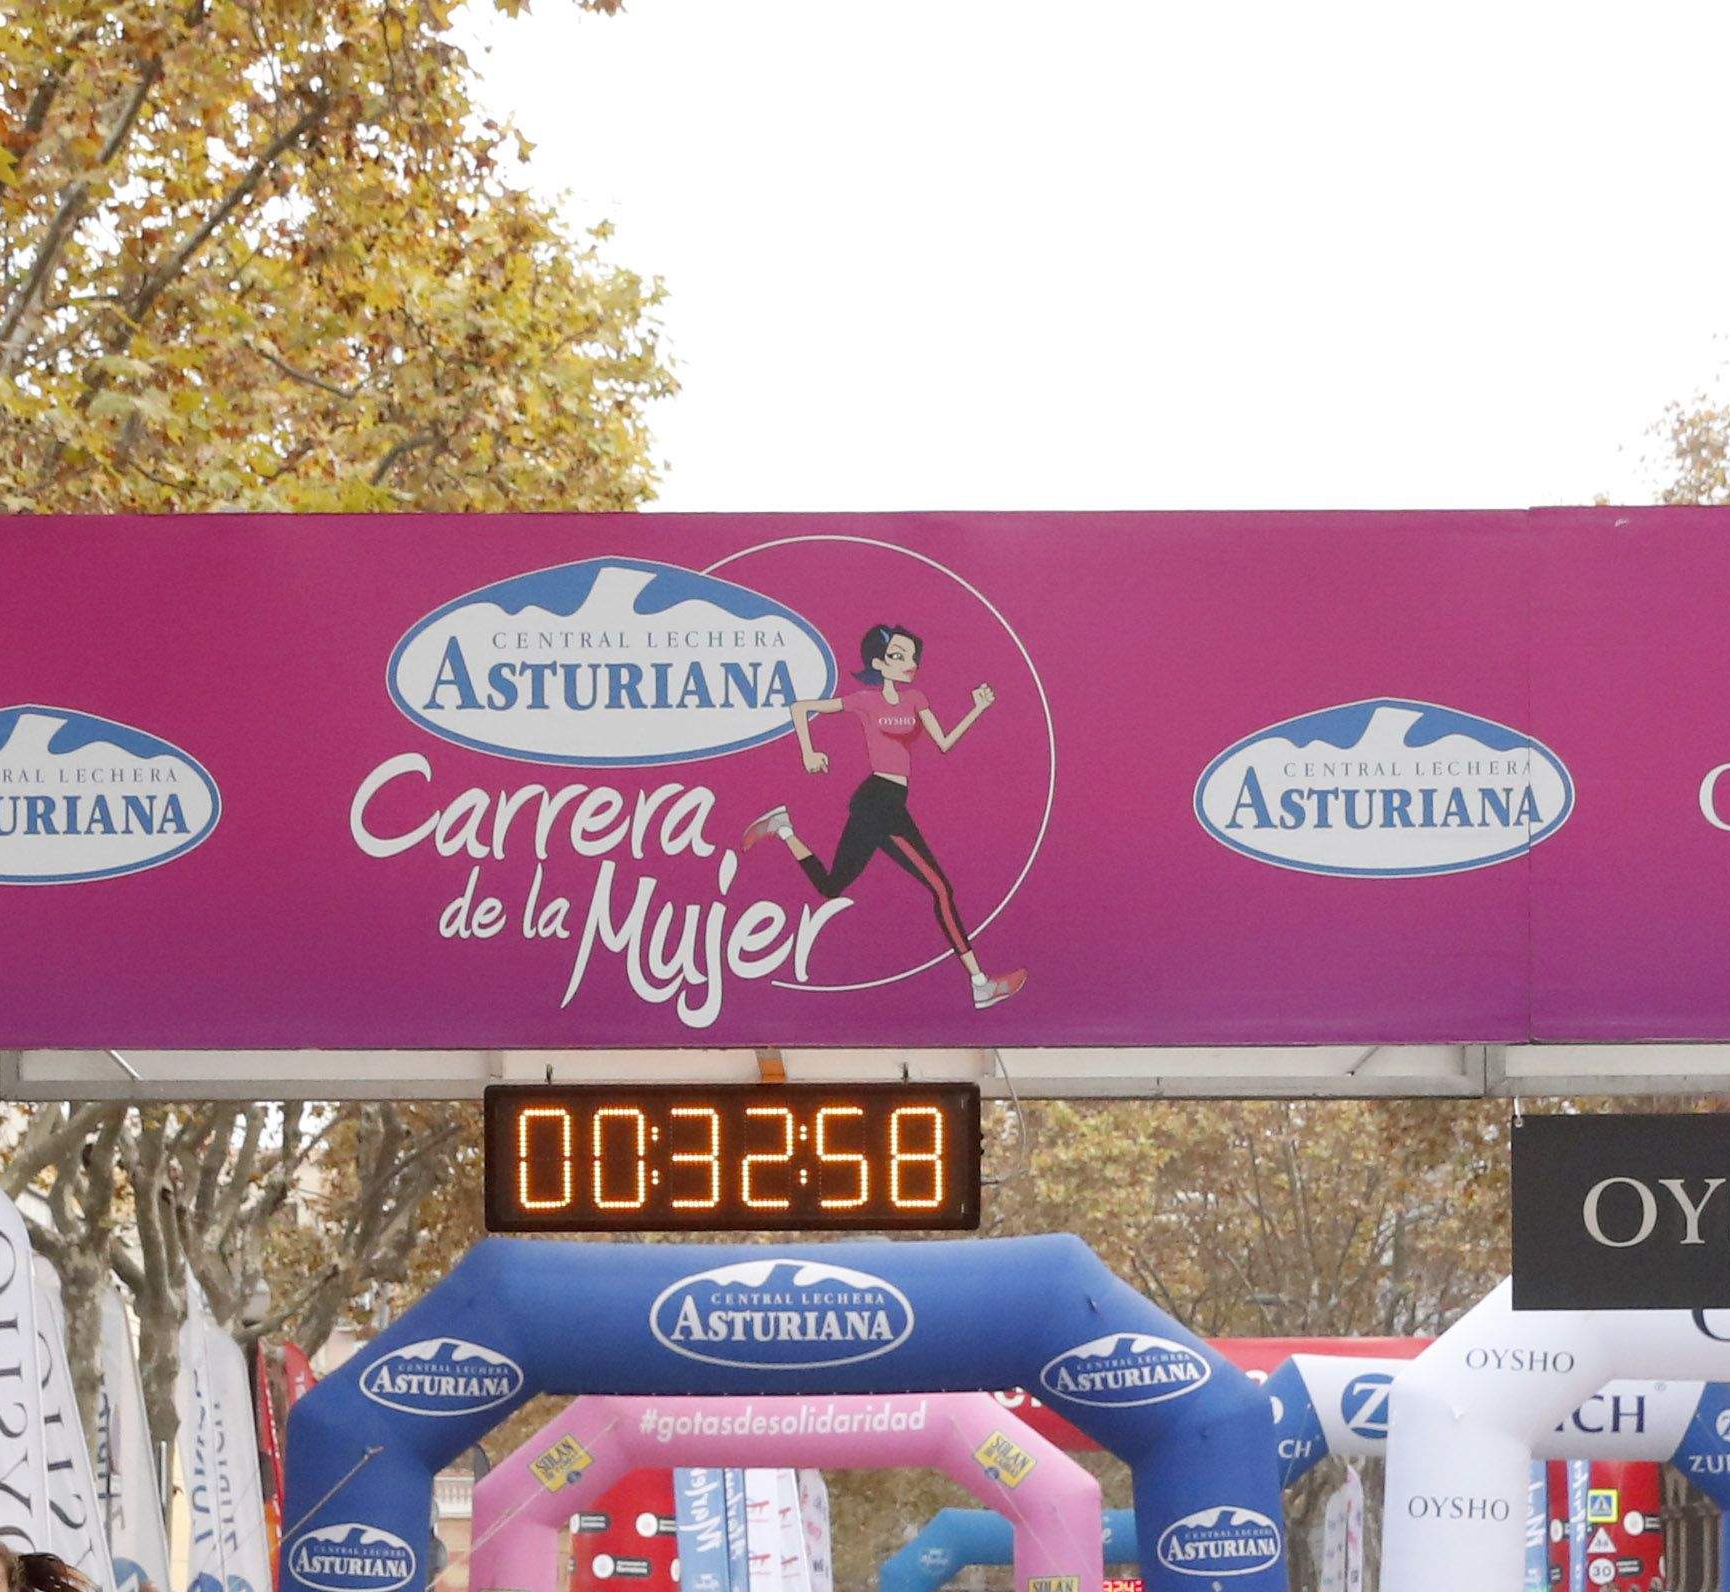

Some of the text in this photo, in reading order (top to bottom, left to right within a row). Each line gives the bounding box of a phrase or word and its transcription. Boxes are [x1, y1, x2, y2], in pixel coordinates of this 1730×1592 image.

[492, 631, 787, 649] CENTRAL LECHERA
[423, 636, 800, 711] ASTURIANA
[878, 716, 917, 726] OYSHO
[60, 768, 179, 783] LECHERA
[1284, 762, 1532, 777] CENTRAL LECHERA
[350, 753, 717, 859] Carrera
[1225, 765, 1544, 831] ASTURIANA
[440, 851, 855, 1028] de la Mujer
[518, 1107, 943, 1209] 00:32:58
[711, 1293, 885, 1304] CENTRAL LECHERA
[670, 1296, 894, 1342] ASTURIANA
[1057, 1361, 1198, 1393] ASTURIANA
[1465, 1347, 1576, 1376] OYSHO
[371, 1366, 510, 1397] ASTURIANA
[639, 1400, 926, 1440] #gotasdesolidaridad
[1408, 1495, 1511, 1522] OYSHO
[296, 1548, 409, 1580] ASTURIANA
[1167, 1535, 1275, 1562] ASTURIANA
[1593, 1564, 1612, 1577] 30
